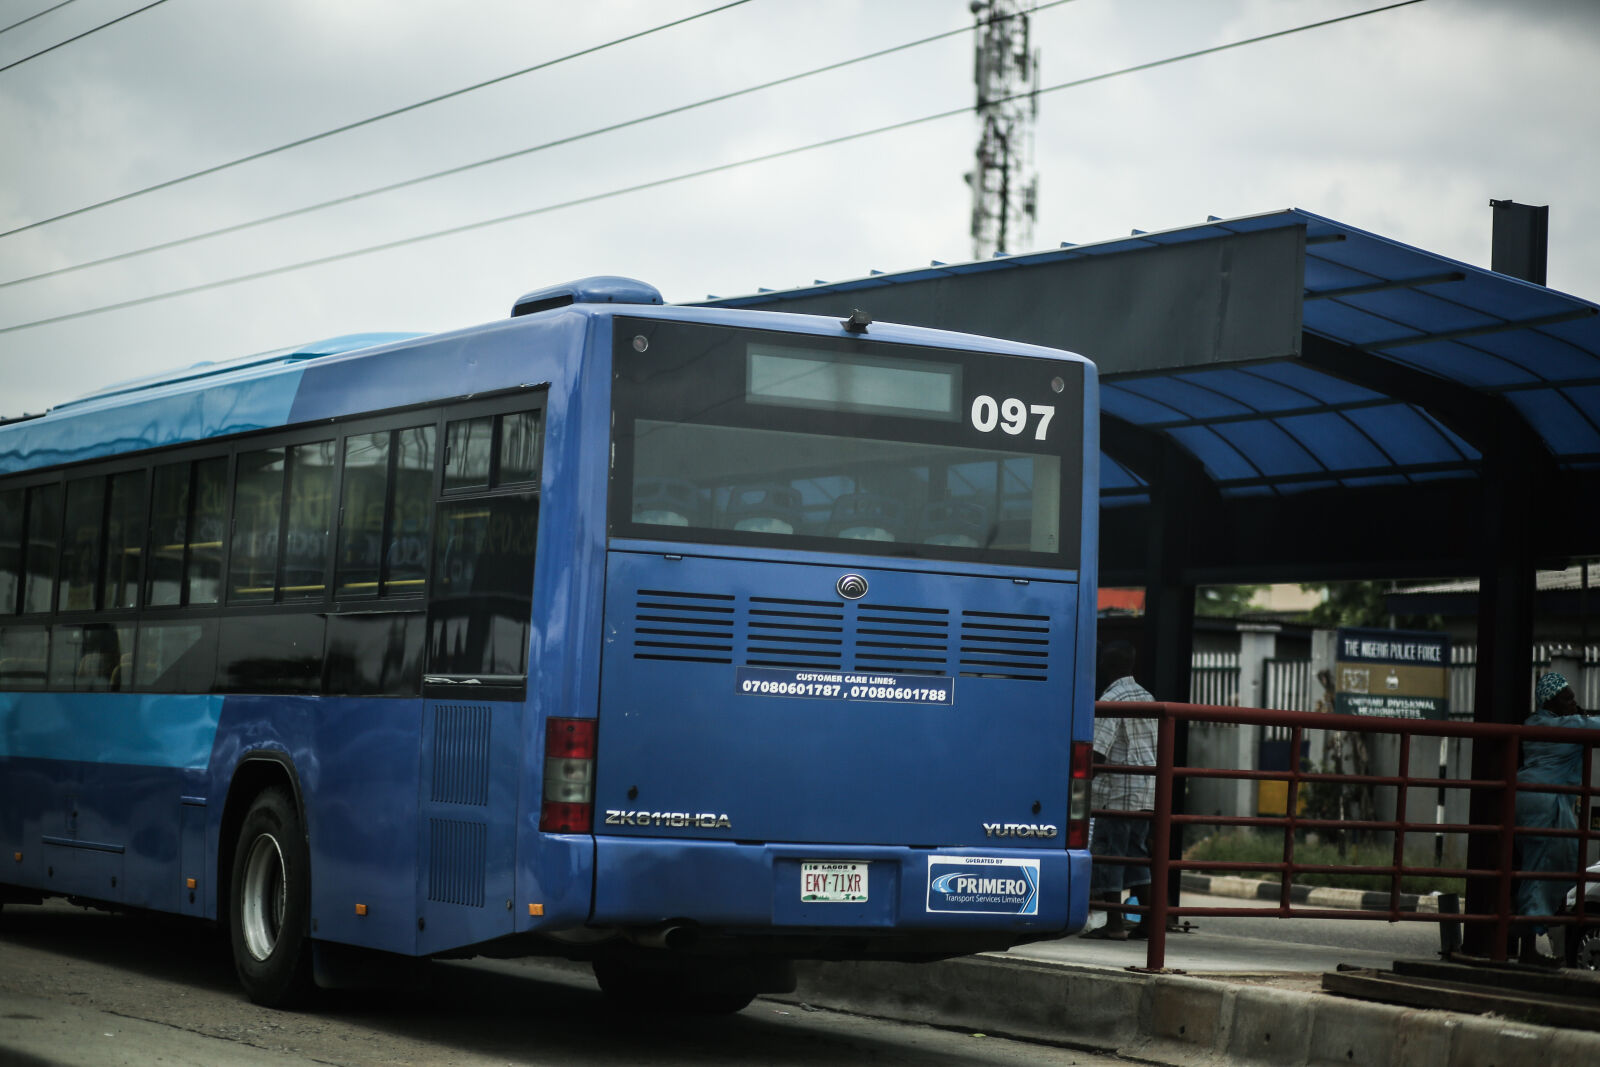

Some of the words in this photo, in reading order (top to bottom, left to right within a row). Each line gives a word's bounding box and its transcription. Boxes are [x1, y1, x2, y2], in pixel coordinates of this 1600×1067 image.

[971, 394, 1055, 441] 097
[1390, 643, 1416, 660] POLICE
[1417, 645, 1441, 662] FORCE
[796, 673, 842, 683] CUSTOMER
[844, 675, 867, 684] CARE
[742, 680, 841, 697] 07080601787
[850, 686, 946, 701] 07080601788
[982, 823, 1057, 838] YUTONG
[965, 857, 994, 865] OPERATED
[957, 878, 1027, 895] PRIMERO
[945, 894, 974, 903] Transport
[975, 895, 1001, 903] Services
[1001, 896, 1025, 904] Limited
